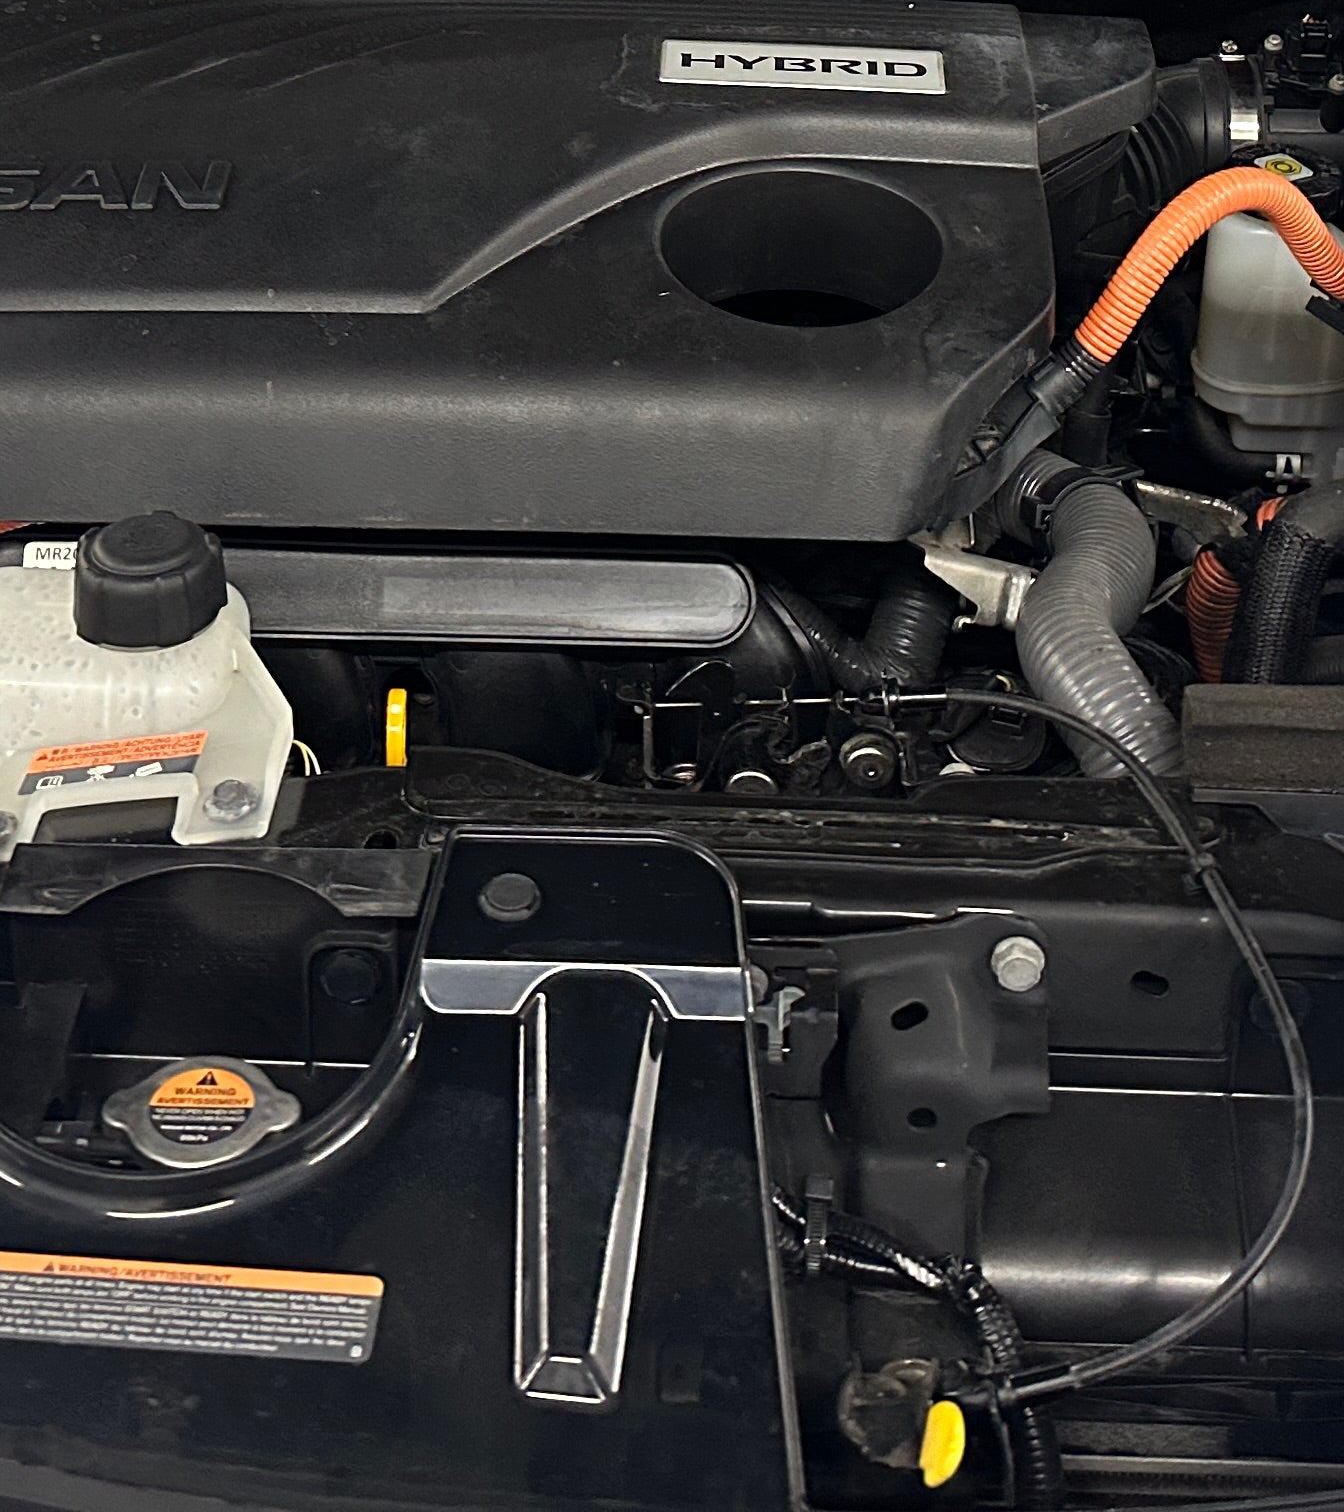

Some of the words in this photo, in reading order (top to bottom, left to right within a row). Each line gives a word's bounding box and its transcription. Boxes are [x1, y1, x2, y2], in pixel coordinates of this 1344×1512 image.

[680, 51, 928, 78] HYBRID
[174, 1087, 237, 1096] WARNING
[156, 1096, 249, 1105] AVERTISSEMENT
